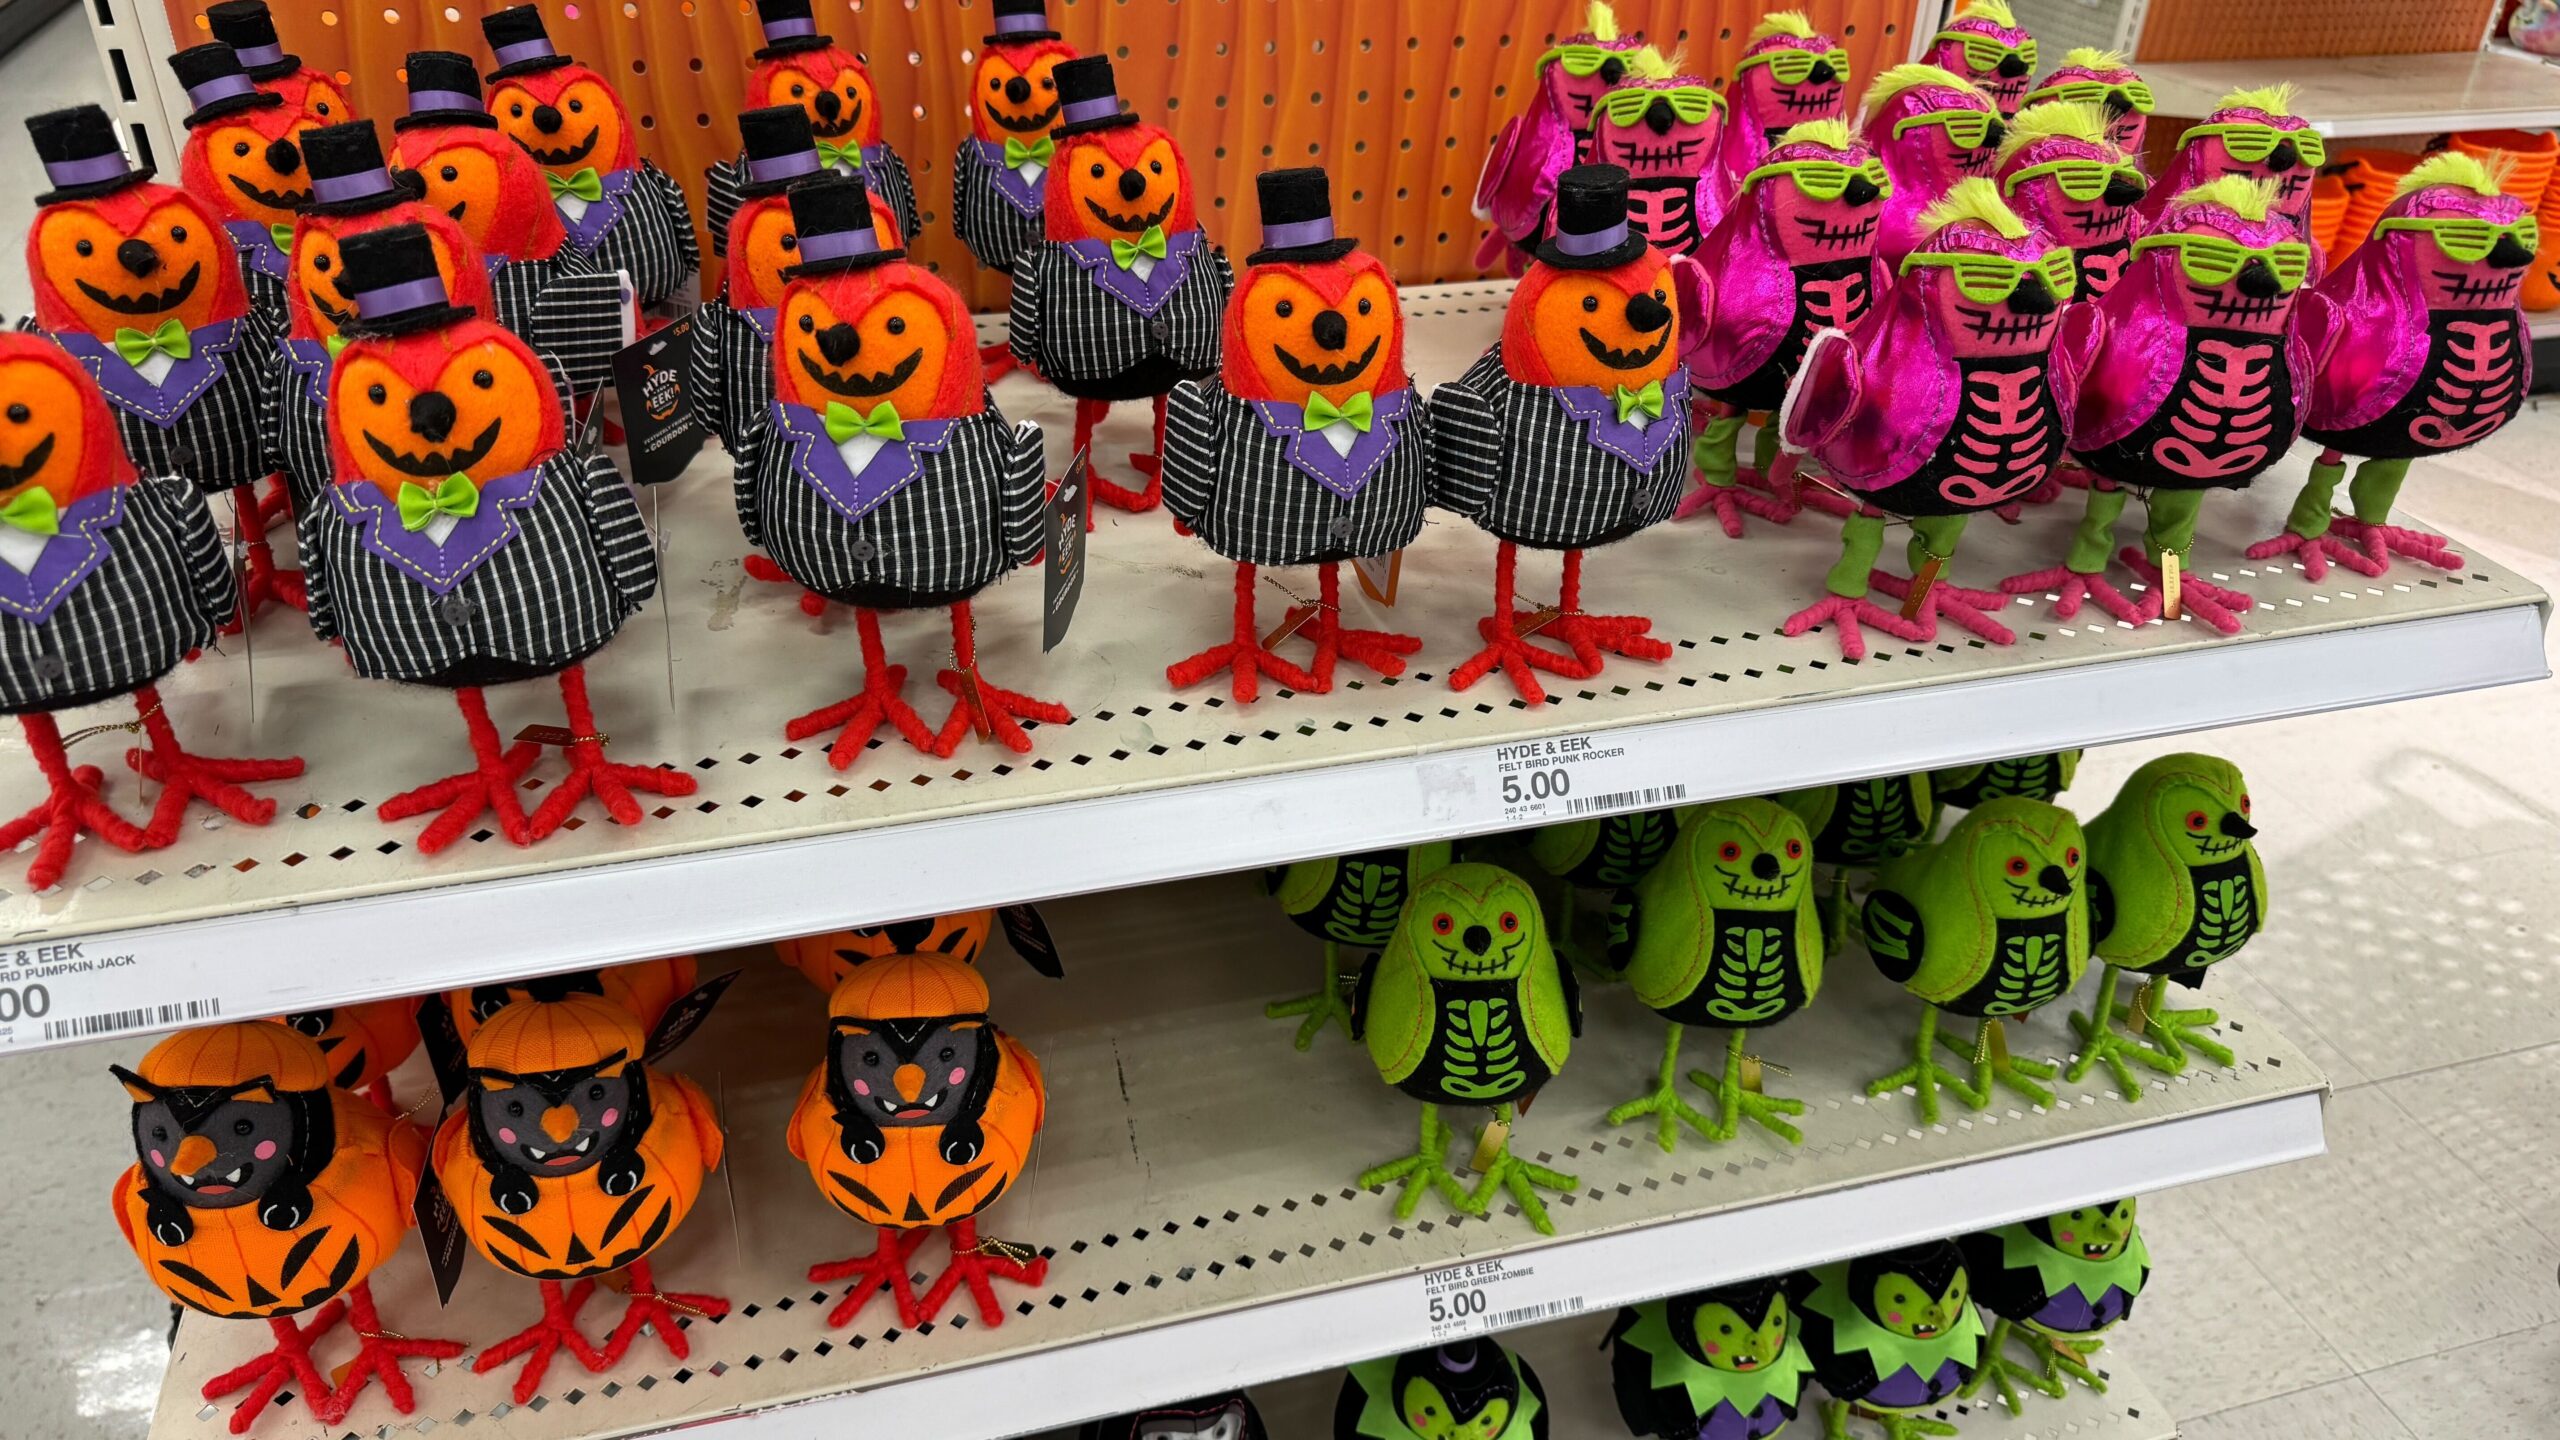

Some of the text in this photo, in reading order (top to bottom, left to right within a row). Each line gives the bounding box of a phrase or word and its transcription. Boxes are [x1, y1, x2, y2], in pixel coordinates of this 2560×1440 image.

[643, 369, 677, 397] HYDE
[652, 387, 675, 408] EEK!
[650, 423, 689, 451] GOURDON
[1497, 736, 1592, 761] HYDE & EEK
[1498, 747, 1625, 772] FELT BIRD PUNK ROCKER
[1502, 768, 1570, 803] 5.00
[1504, 807, 1517, 815] 240
[15, 950, 31, 966] &
[38, 942, 84, 964] EEK
[25, 960, 93, 980] PUMPKIN
[97, 954, 136, 970] JACK
[1424, 1259, 1504, 1286] HYDE & EEK
[1425, 1267, 1534, 1296] FELT BIRD GREEN ZOMBIE
[1430, 1289, 1486, 1322] 5.00
